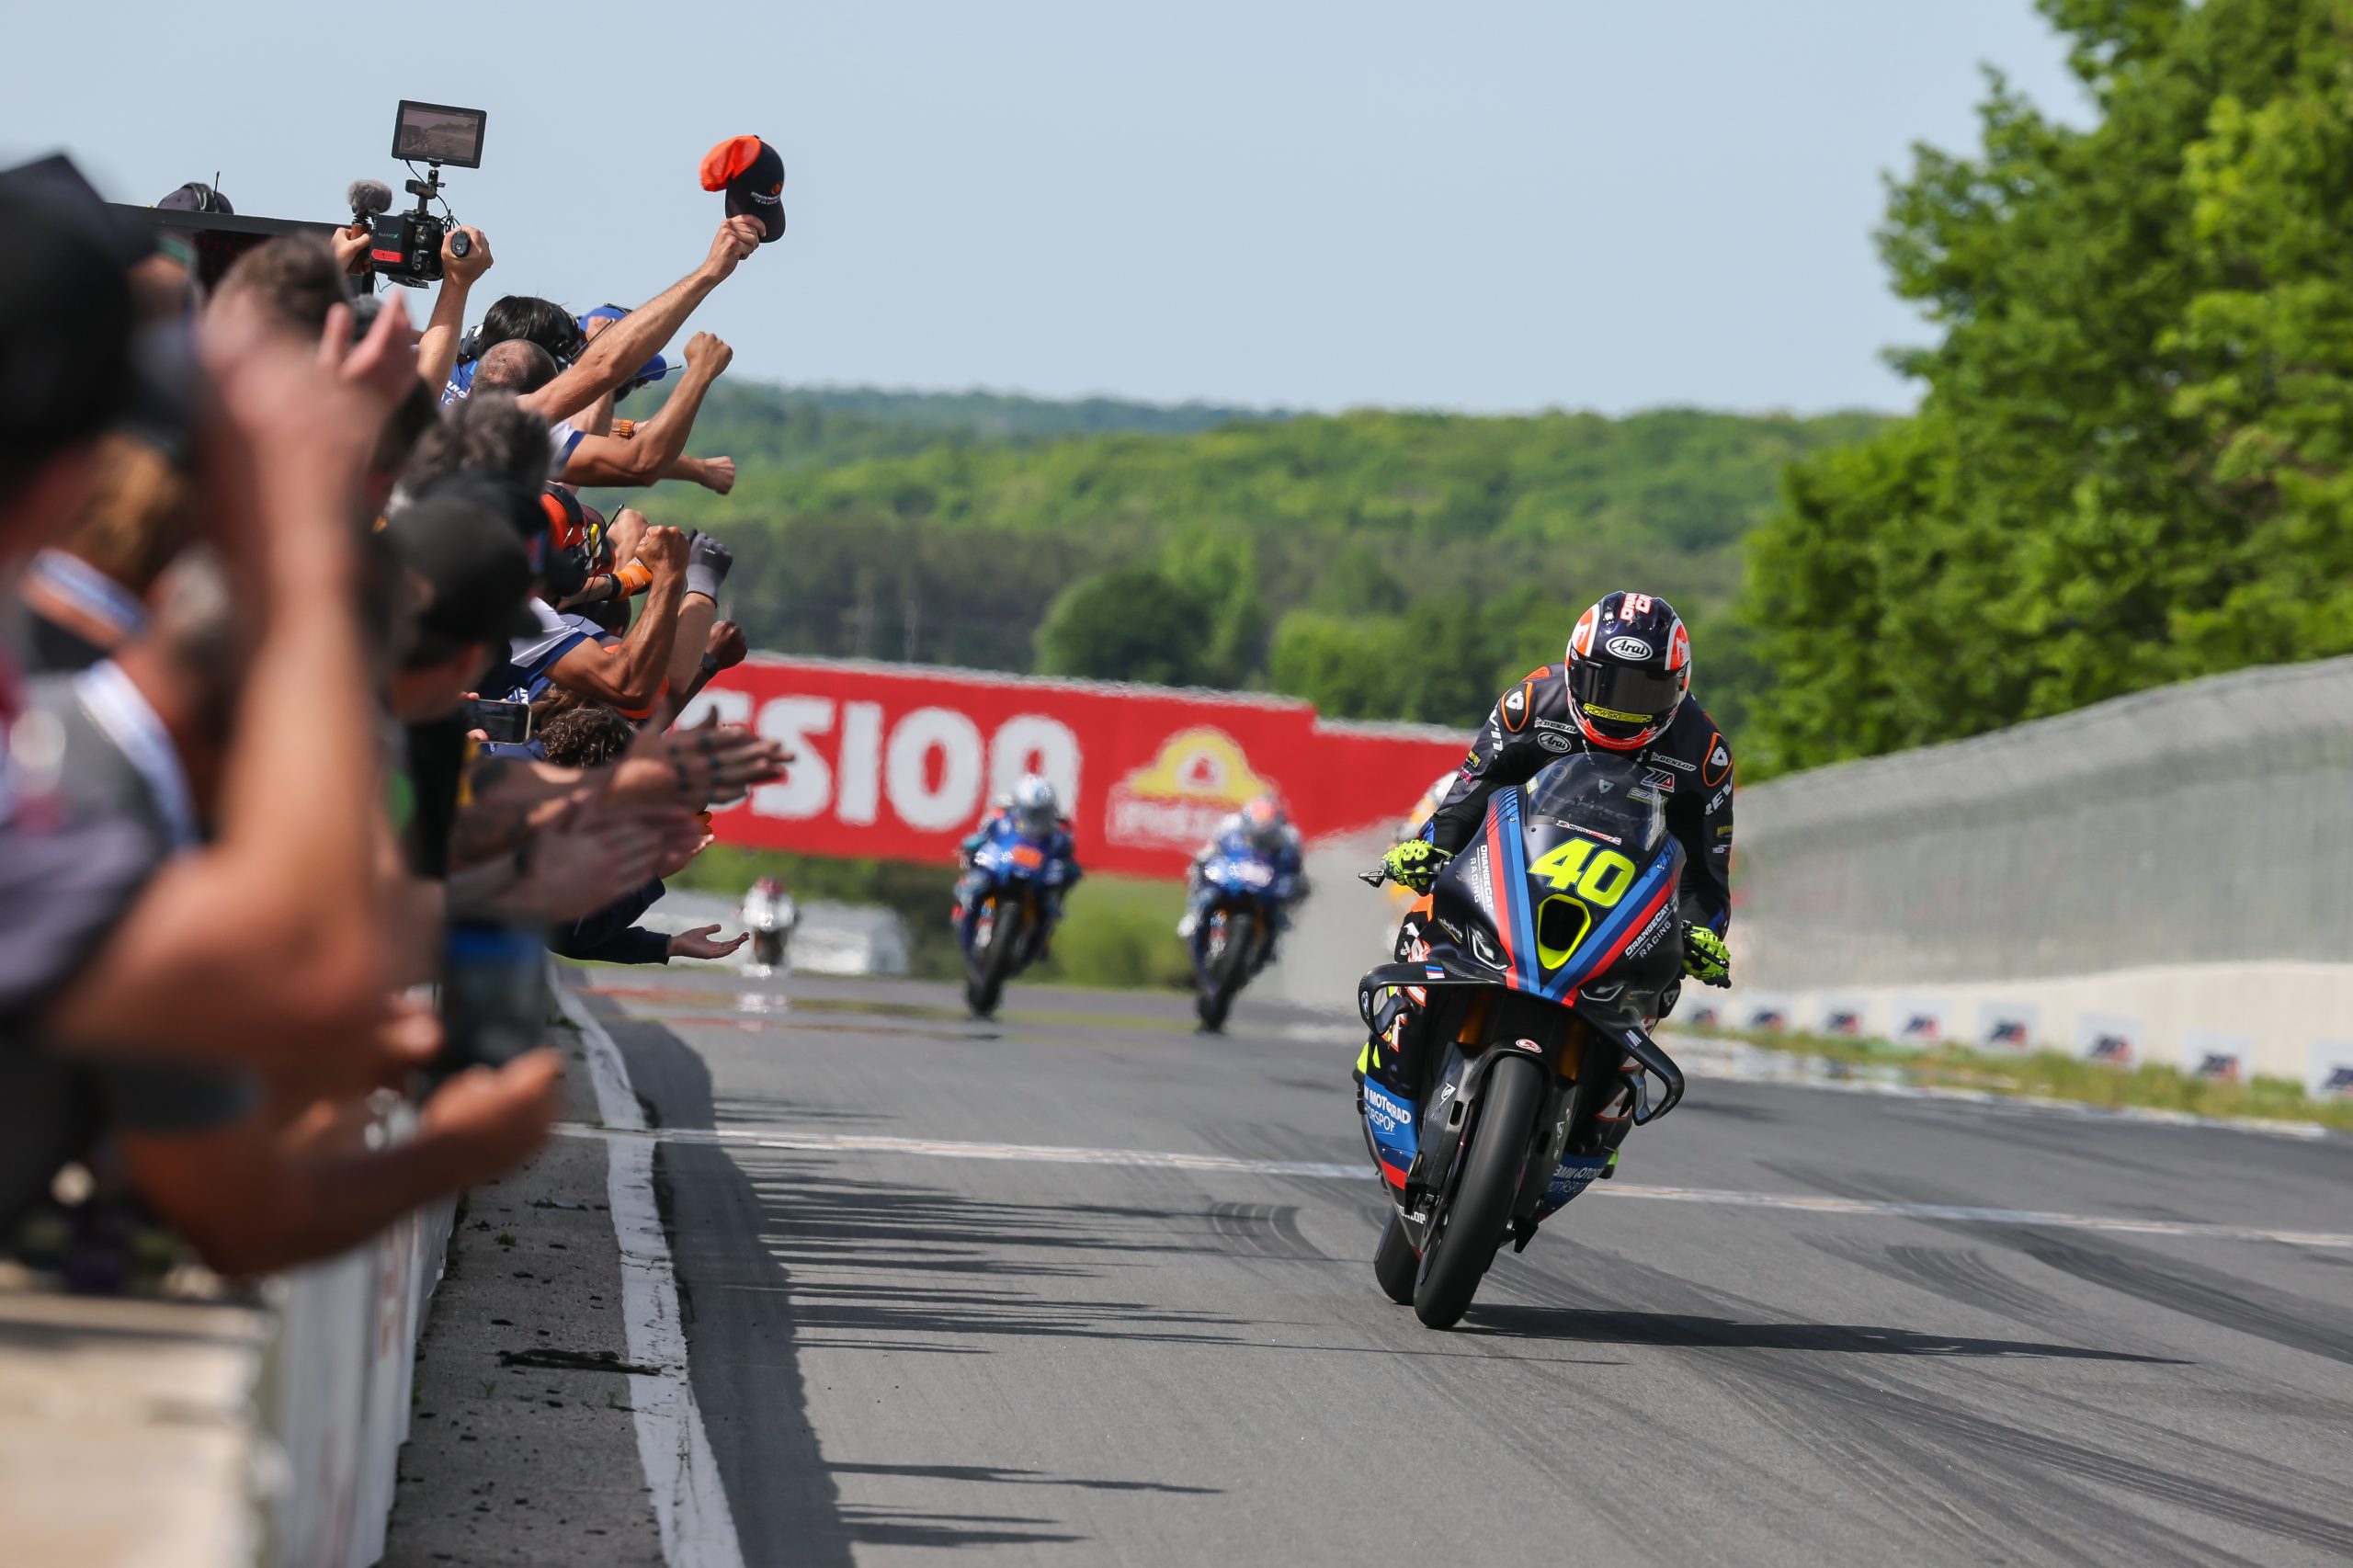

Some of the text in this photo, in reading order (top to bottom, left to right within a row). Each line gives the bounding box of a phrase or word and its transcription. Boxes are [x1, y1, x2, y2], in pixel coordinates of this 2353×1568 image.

[1611, 640, 1647, 655] Arai
[1544, 736, 1567, 749] Arai
[1659, 756, 1695, 770] DUNLOP
[1471, 858, 1481, 903] RACING
[1481, 845, 1494, 910] ORANGECAT
[1527, 837, 1635, 907] 40
[1624, 903, 1670, 957] ORANGECAT
[1639, 921, 1672, 958] RACING
